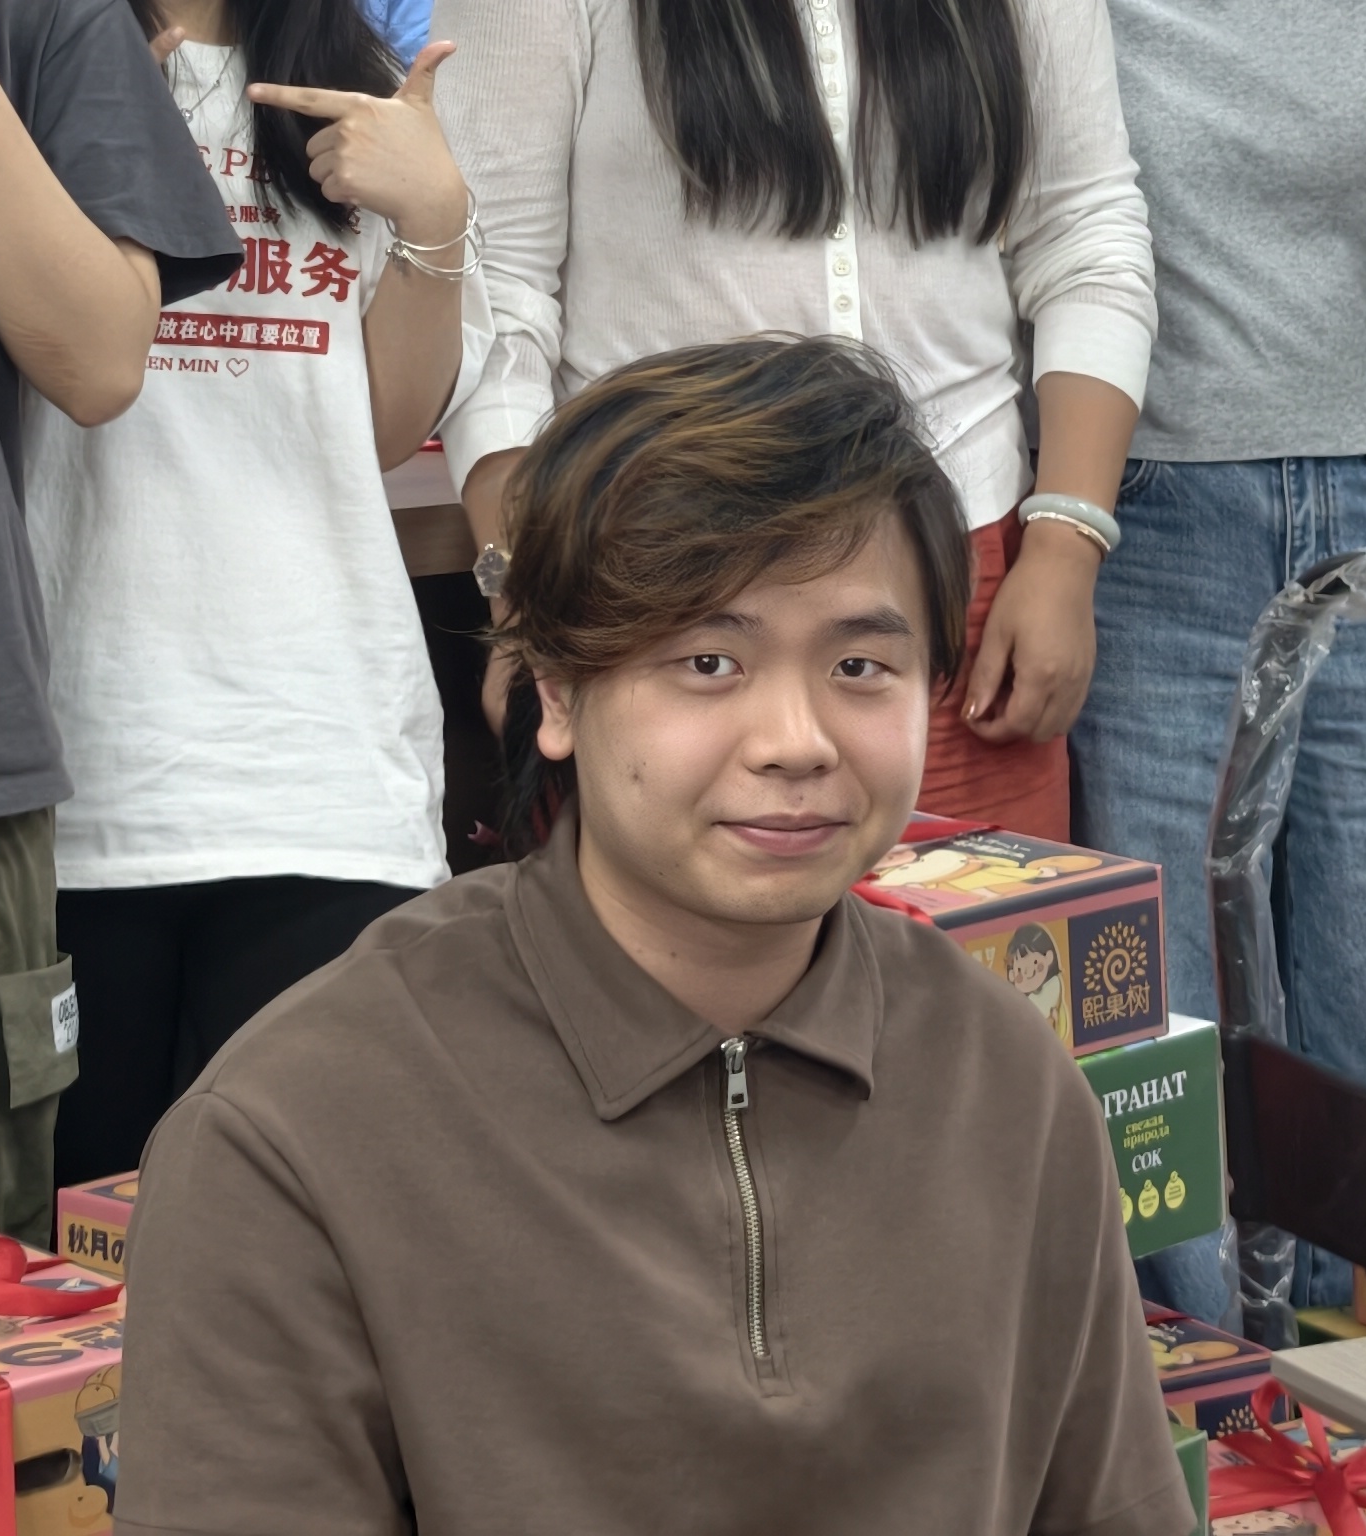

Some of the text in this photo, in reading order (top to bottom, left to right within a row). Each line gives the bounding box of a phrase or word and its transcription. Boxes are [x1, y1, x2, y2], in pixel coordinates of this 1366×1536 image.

[157, 317, 321, 349] 放在心中重要位置
[146, 355, 220, 373] EN MIN
[1082, 979, 1150, 1029] 熙果树
[1103, 1070, 1187, 1119] ГРАНАТ
[1131, 1147, 1163, 1173] СОК
